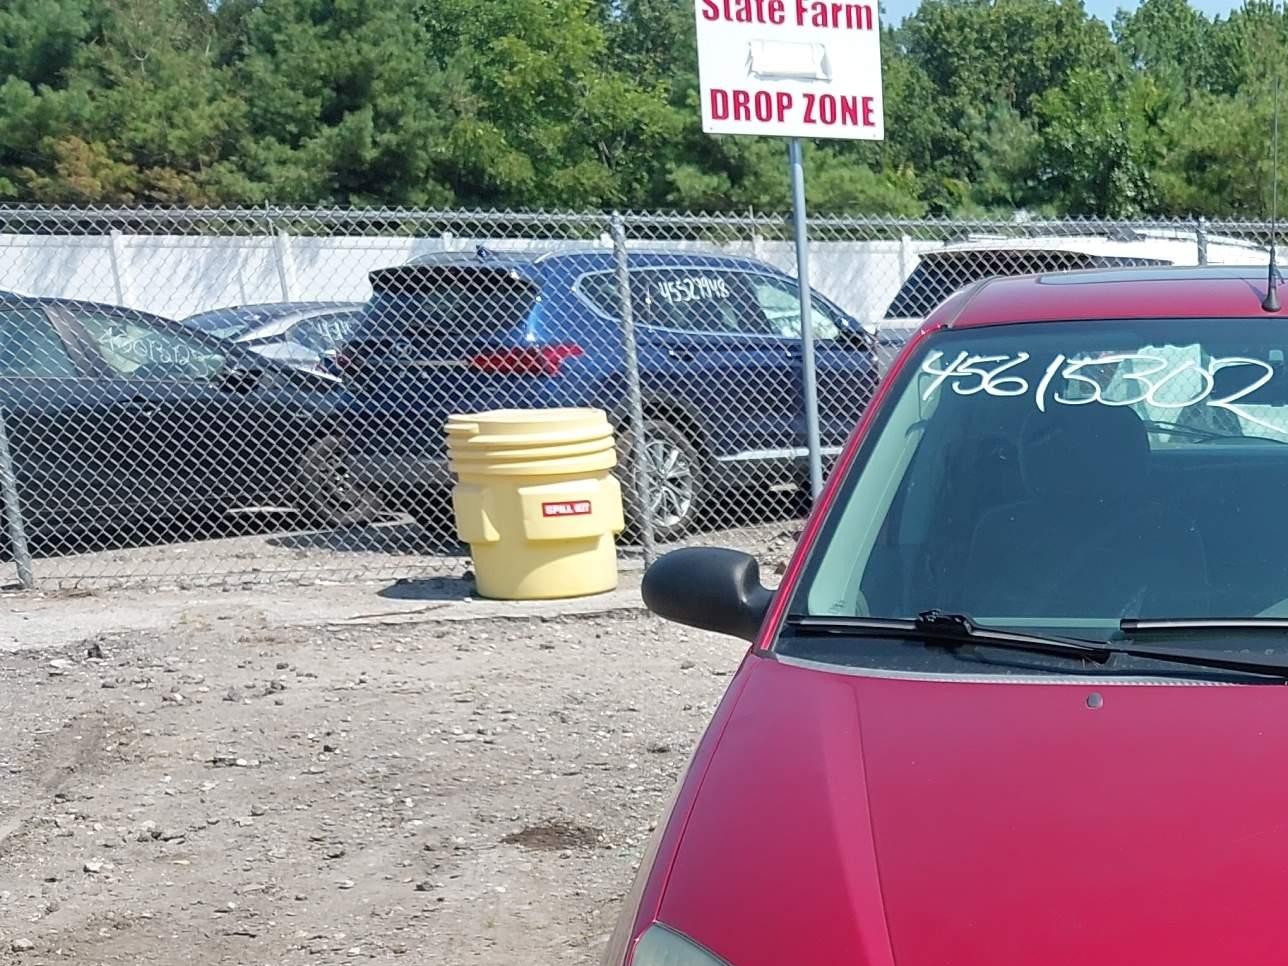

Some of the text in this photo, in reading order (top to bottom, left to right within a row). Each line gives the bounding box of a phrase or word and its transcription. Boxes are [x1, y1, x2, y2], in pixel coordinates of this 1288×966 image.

[702, 0, 873, 31] State Farm
[710, 88, 876, 127] DROP ZONE
[922, 350, 1288, 434] 45615302
